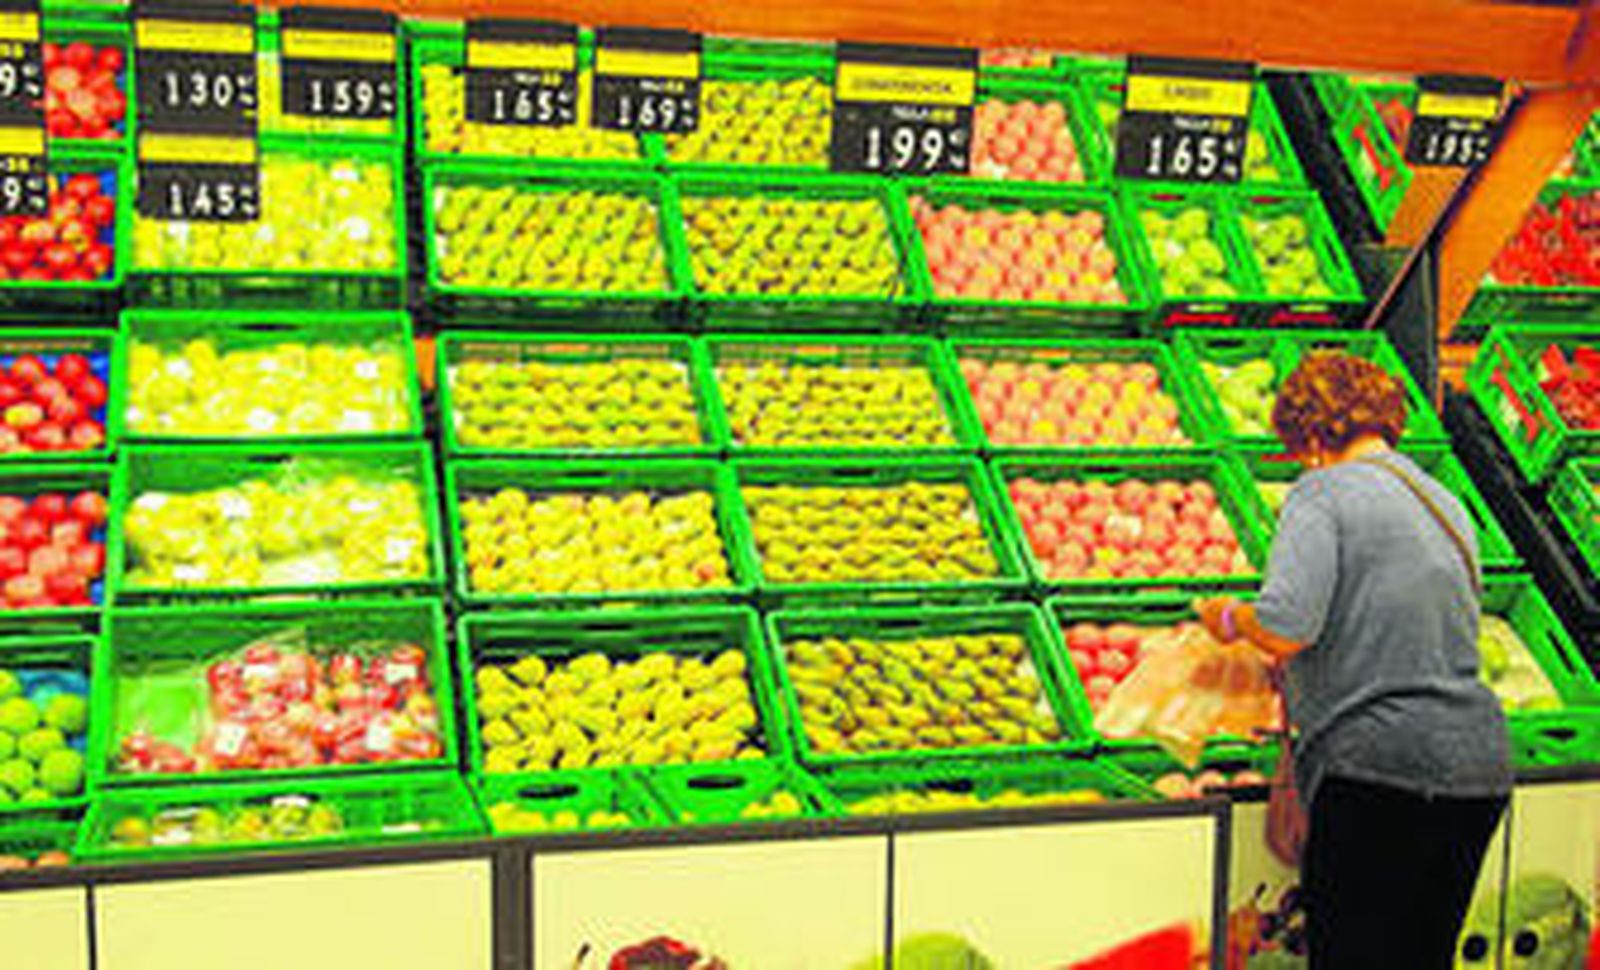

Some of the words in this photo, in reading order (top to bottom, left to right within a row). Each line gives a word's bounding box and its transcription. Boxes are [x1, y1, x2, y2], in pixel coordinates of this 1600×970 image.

[165, 71, 234, 107] 130
[311, 79, 374, 115] 159
[493, 89, 554, 121] 165
[618, 95, 676, 129] 169
[866, 126, 944, 170] 199
[1146, 135, 1219, 177] 165
